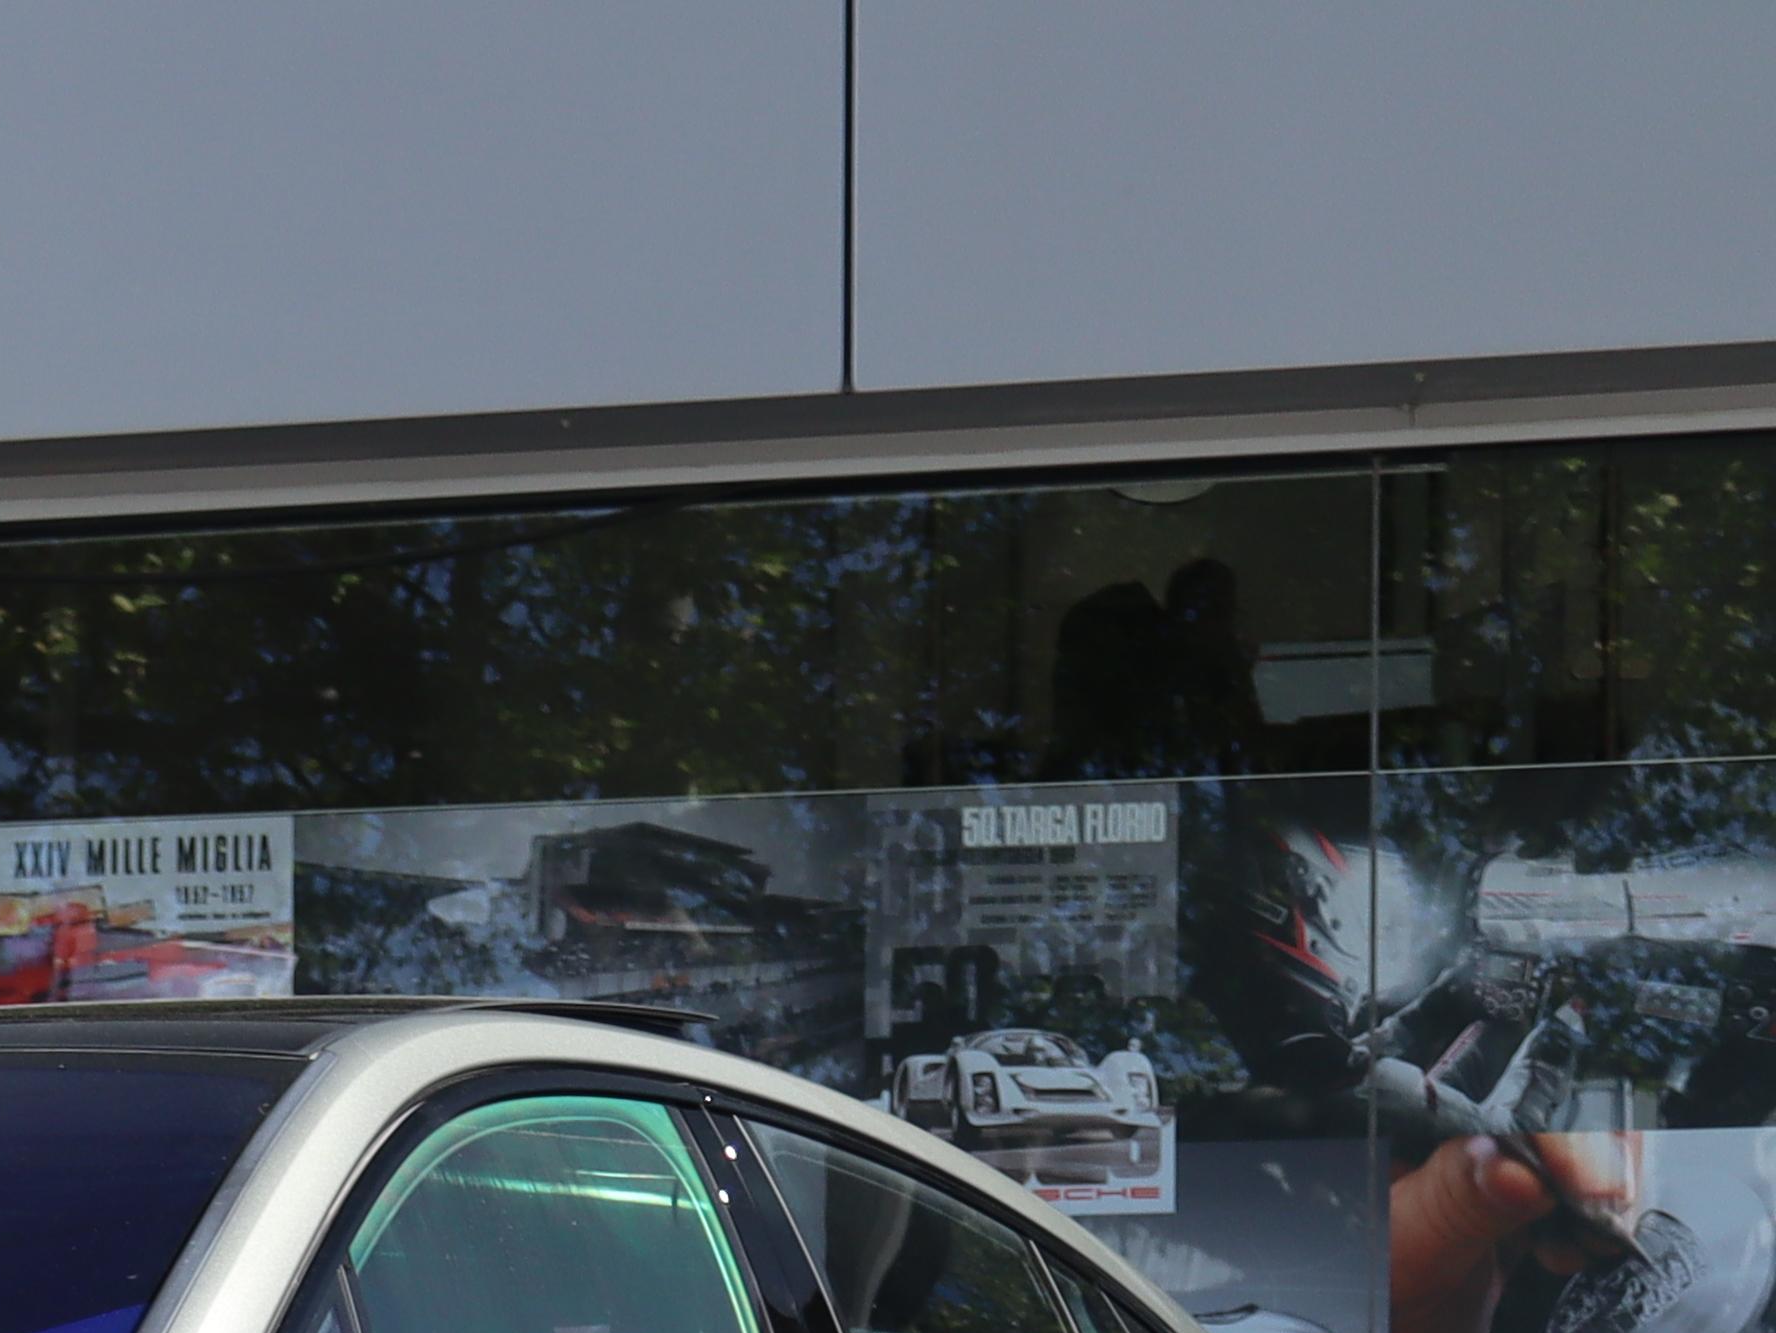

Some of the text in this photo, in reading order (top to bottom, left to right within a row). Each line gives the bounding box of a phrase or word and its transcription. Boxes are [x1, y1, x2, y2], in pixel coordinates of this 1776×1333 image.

[1003, 805, 1080, 845] TARGA
[1083, 802, 1167, 843] FLORIO
[14, 833, 272, 878] XXIV MILLE MIGLIA
[1033, 1186, 1161, 1201] SCHE
